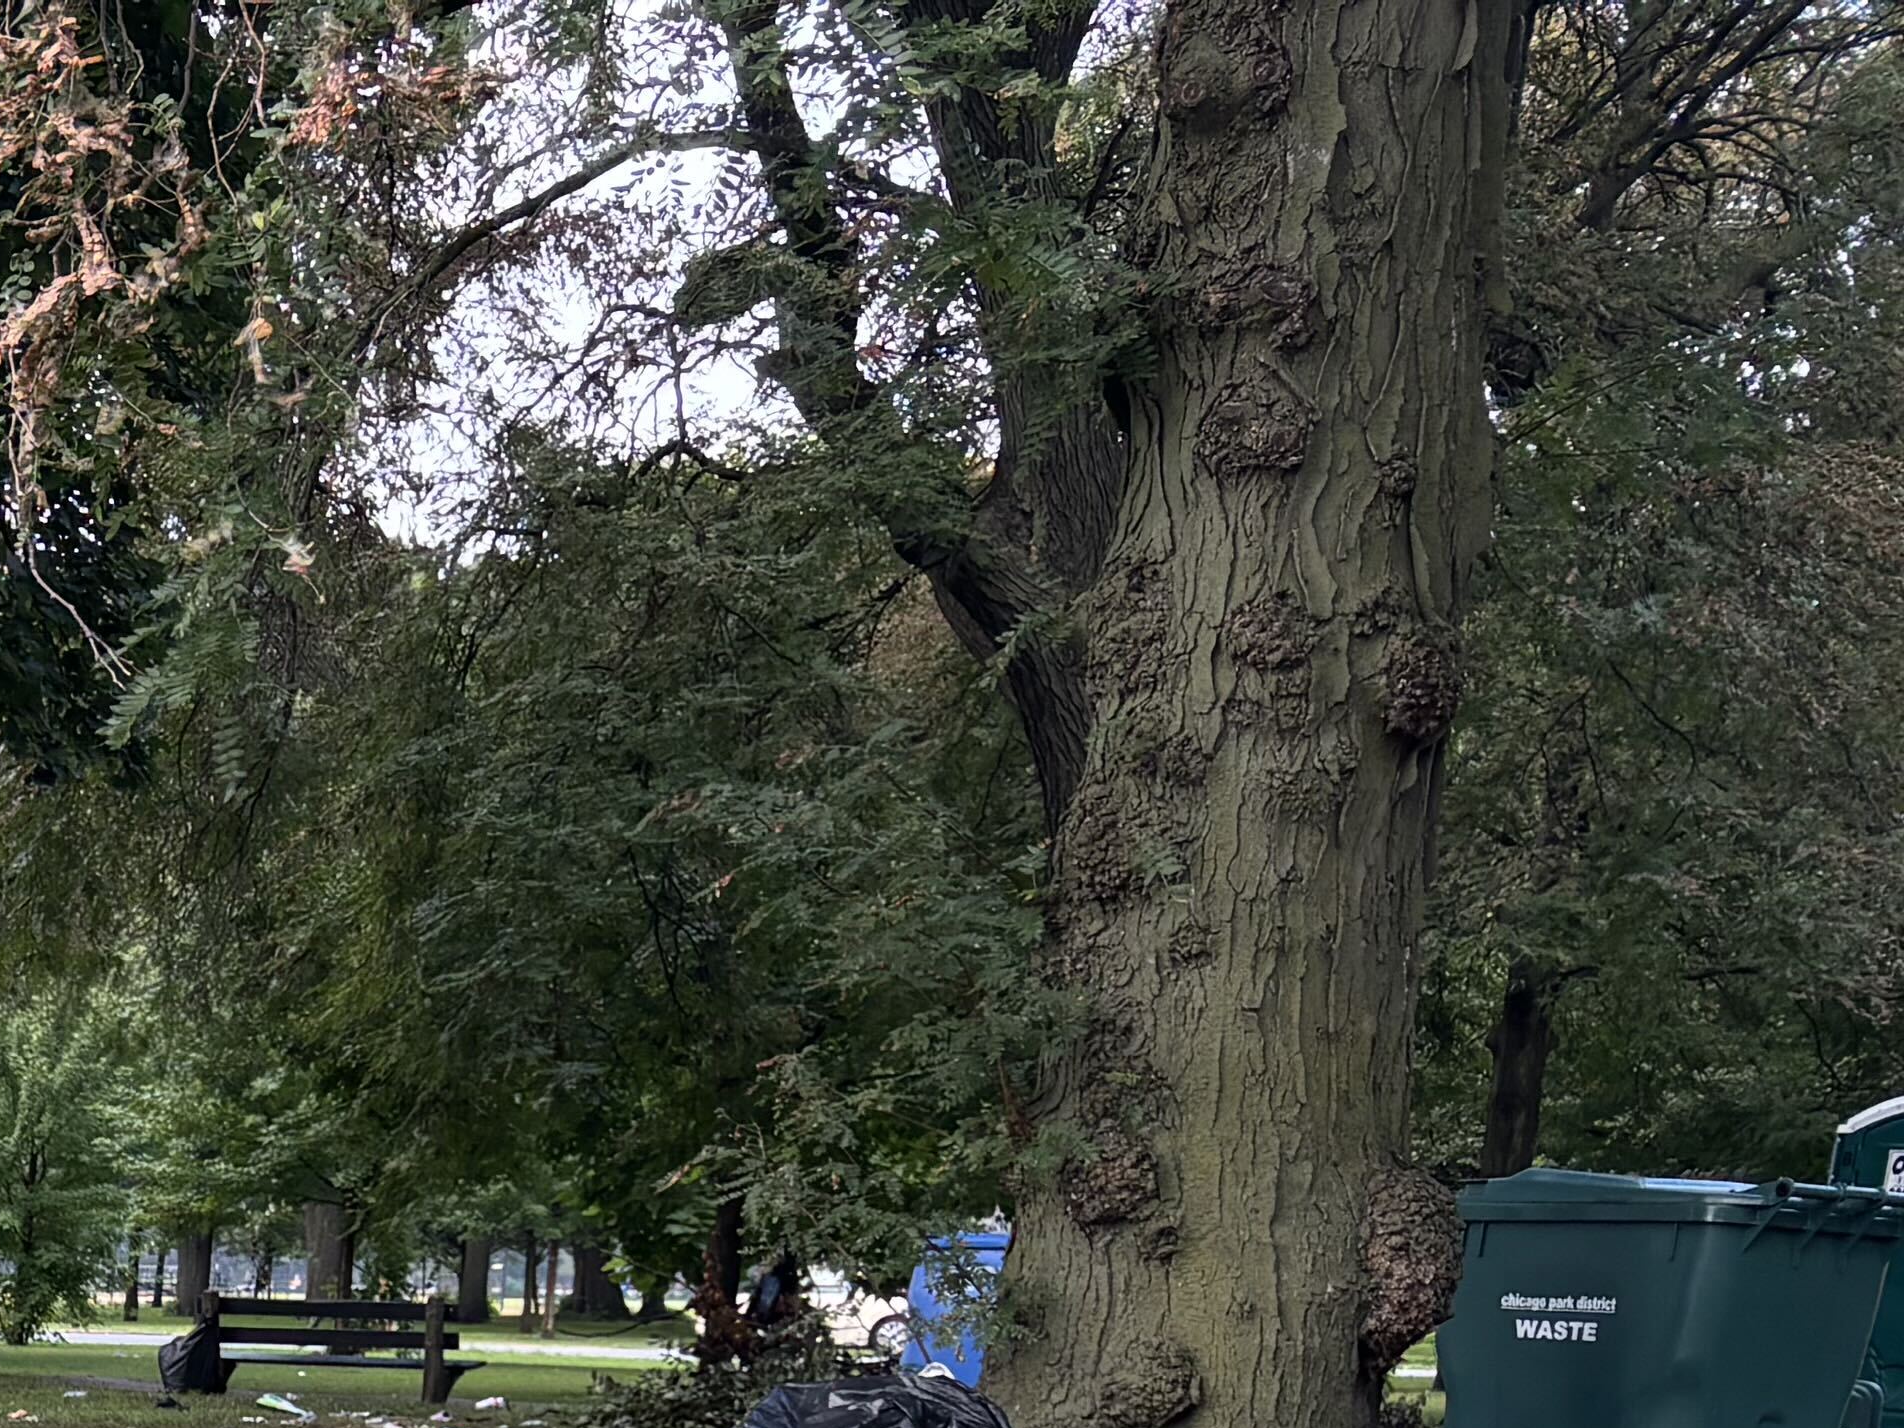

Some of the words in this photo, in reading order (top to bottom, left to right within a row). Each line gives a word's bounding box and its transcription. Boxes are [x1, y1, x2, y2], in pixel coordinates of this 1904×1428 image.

[1501, 1293, 1546, 1310] chicago
[1549, 1296, 1574, 1311] park
[1576, 1296, 1616, 1311] district
[1516, 1319, 1598, 1341] WASTE
